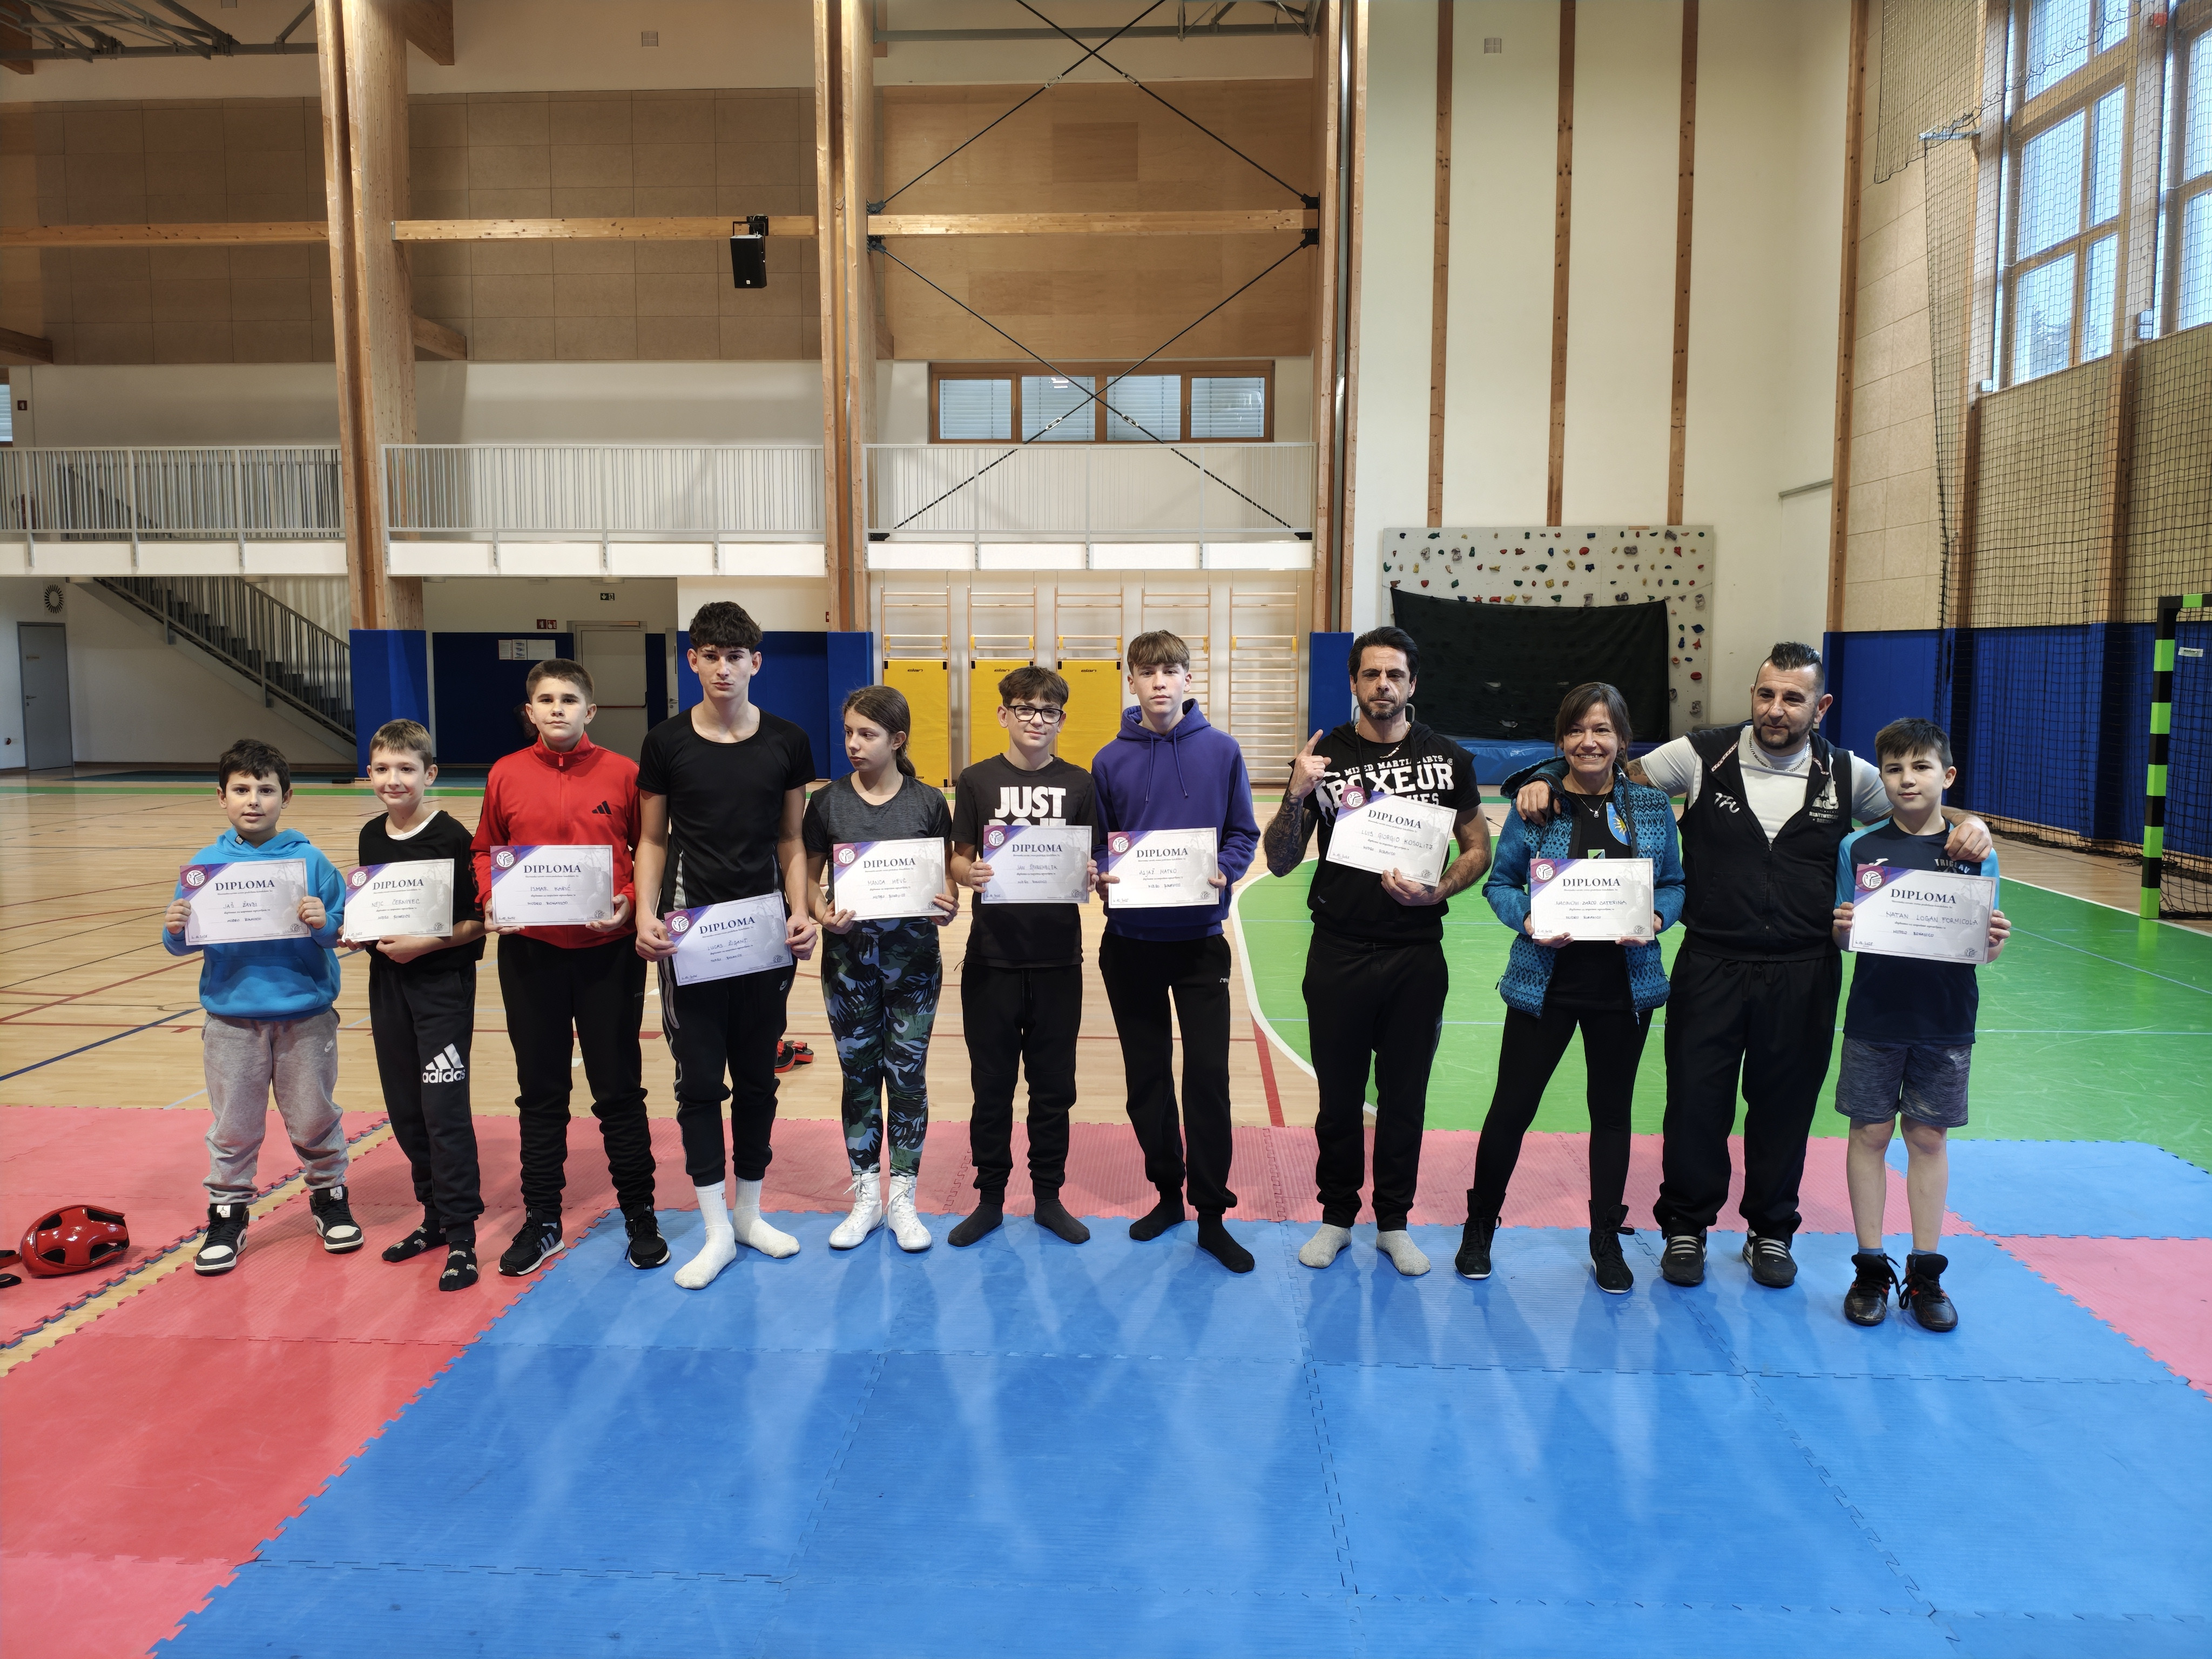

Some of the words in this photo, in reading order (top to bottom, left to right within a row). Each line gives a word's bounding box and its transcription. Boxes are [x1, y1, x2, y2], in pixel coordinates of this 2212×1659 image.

[1377, 758, 1420, 770] MARTIL
[995, 786, 1066, 818] JUST
[1367, 809, 1422, 830] DIPLOMA
[1012, 844, 1062, 852] DIPLOMA
[1136, 848, 1188, 858] DIPLOMA
[523, 865, 581, 873] DIPLOMA
[863, 858, 916, 869] DIPLOMA
[215, 880, 275, 891] DIPLOMA
[373, 879, 424, 891] DIPLOMA
[1562, 878, 1621, 887] DIPLOMA
[1890, 888, 1957, 904] DIPLOMA
[1886, 911, 1908, 919] NATAN
[1916, 914, 1938, 923] LOGAN
[699, 916, 756, 935] DIPLOMA
[422, 1068, 466, 1083] adidas
